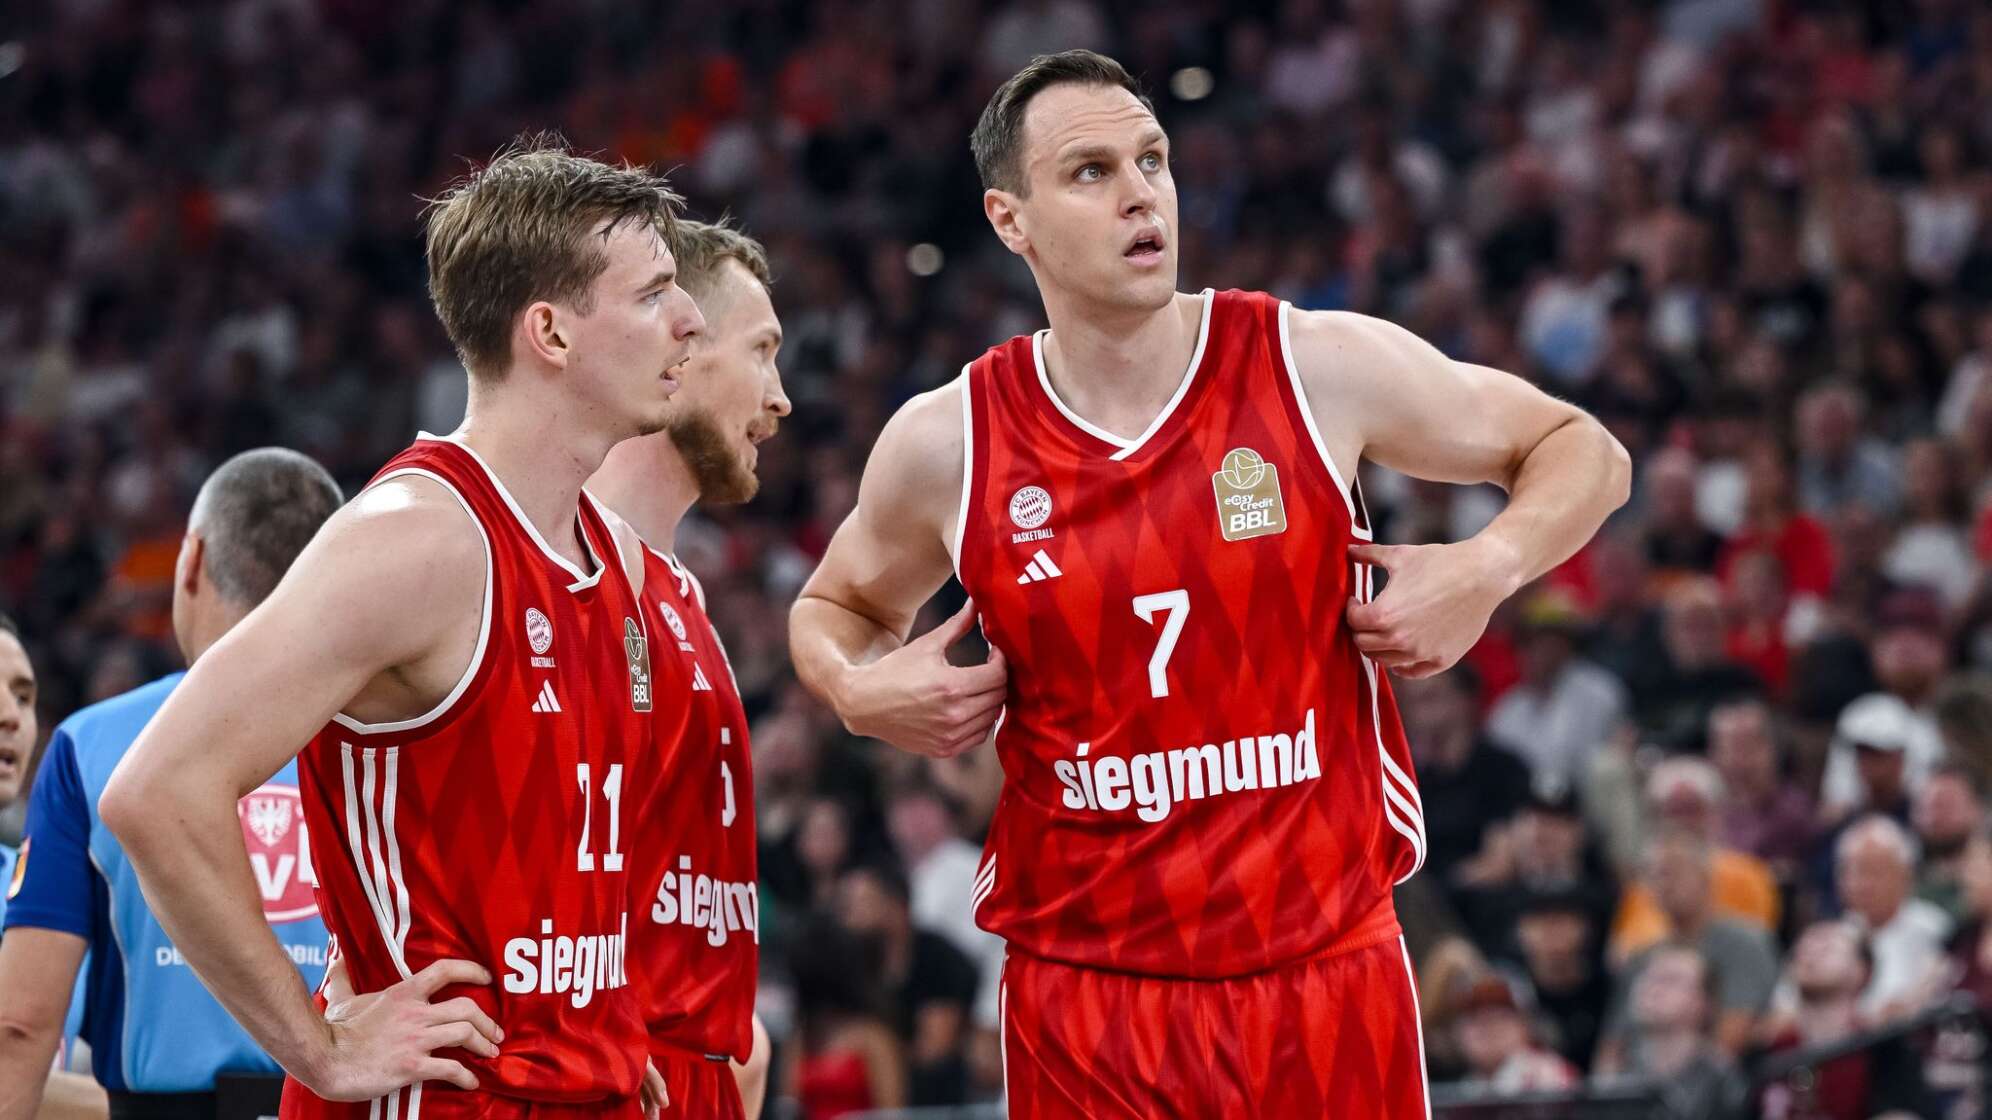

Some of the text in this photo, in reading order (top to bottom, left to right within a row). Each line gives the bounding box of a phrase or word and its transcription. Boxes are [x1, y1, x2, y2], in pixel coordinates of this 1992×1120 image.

[1020, 490, 1047, 502] BAYERN
[1240, 498, 1273, 511] Credit
[1230, 509, 1277, 533] BBL
[1011, 527, 1055, 544] BASKETBALL
[1132, 588, 1191, 698] 7
[633, 684, 649, 703] BBL
[1054, 707, 1322, 822] siegmund
[576, 763, 624, 872] 21
[651, 854, 759, 947] siegm
